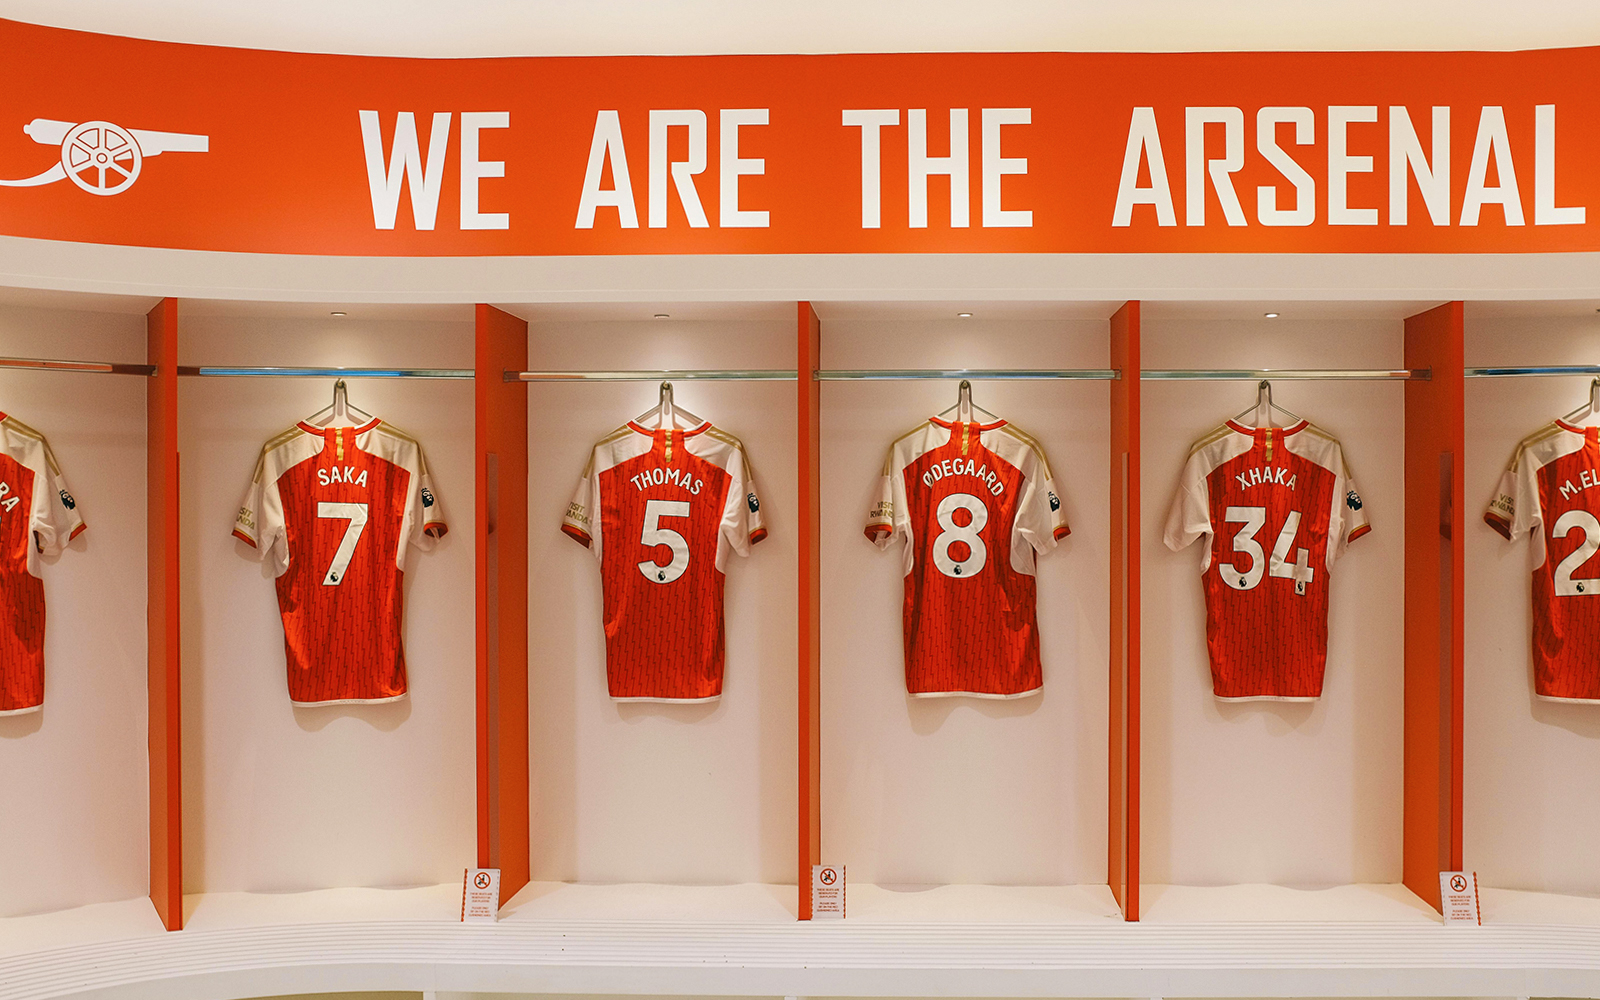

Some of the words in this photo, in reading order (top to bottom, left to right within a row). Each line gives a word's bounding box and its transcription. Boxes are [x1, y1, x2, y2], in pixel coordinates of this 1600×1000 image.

[358, 109, 510, 231] WE
[574, 108, 770, 229] ARE
[841, 107, 1033, 229] THE
[1111, 104, 1586, 227] ARSENAL
[317, 466, 368, 488] SAKA
[630, 467, 704, 495] THOMAS
[922, 458, 1004, 497] ØDEGAARD
[1235, 466, 1297, 491] XHAKA
[236, 515, 256, 530] NDA
[565, 509, 588, 525] ANDA
[569, 501, 585, 513] ISIT
[317, 502, 368, 586] 7
[638, 499, 691, 584] 5
[933, 493, 989, 578] 8
[1218, 506, 1314, 596] 34
[1552, 509, 1600, 597] 2
